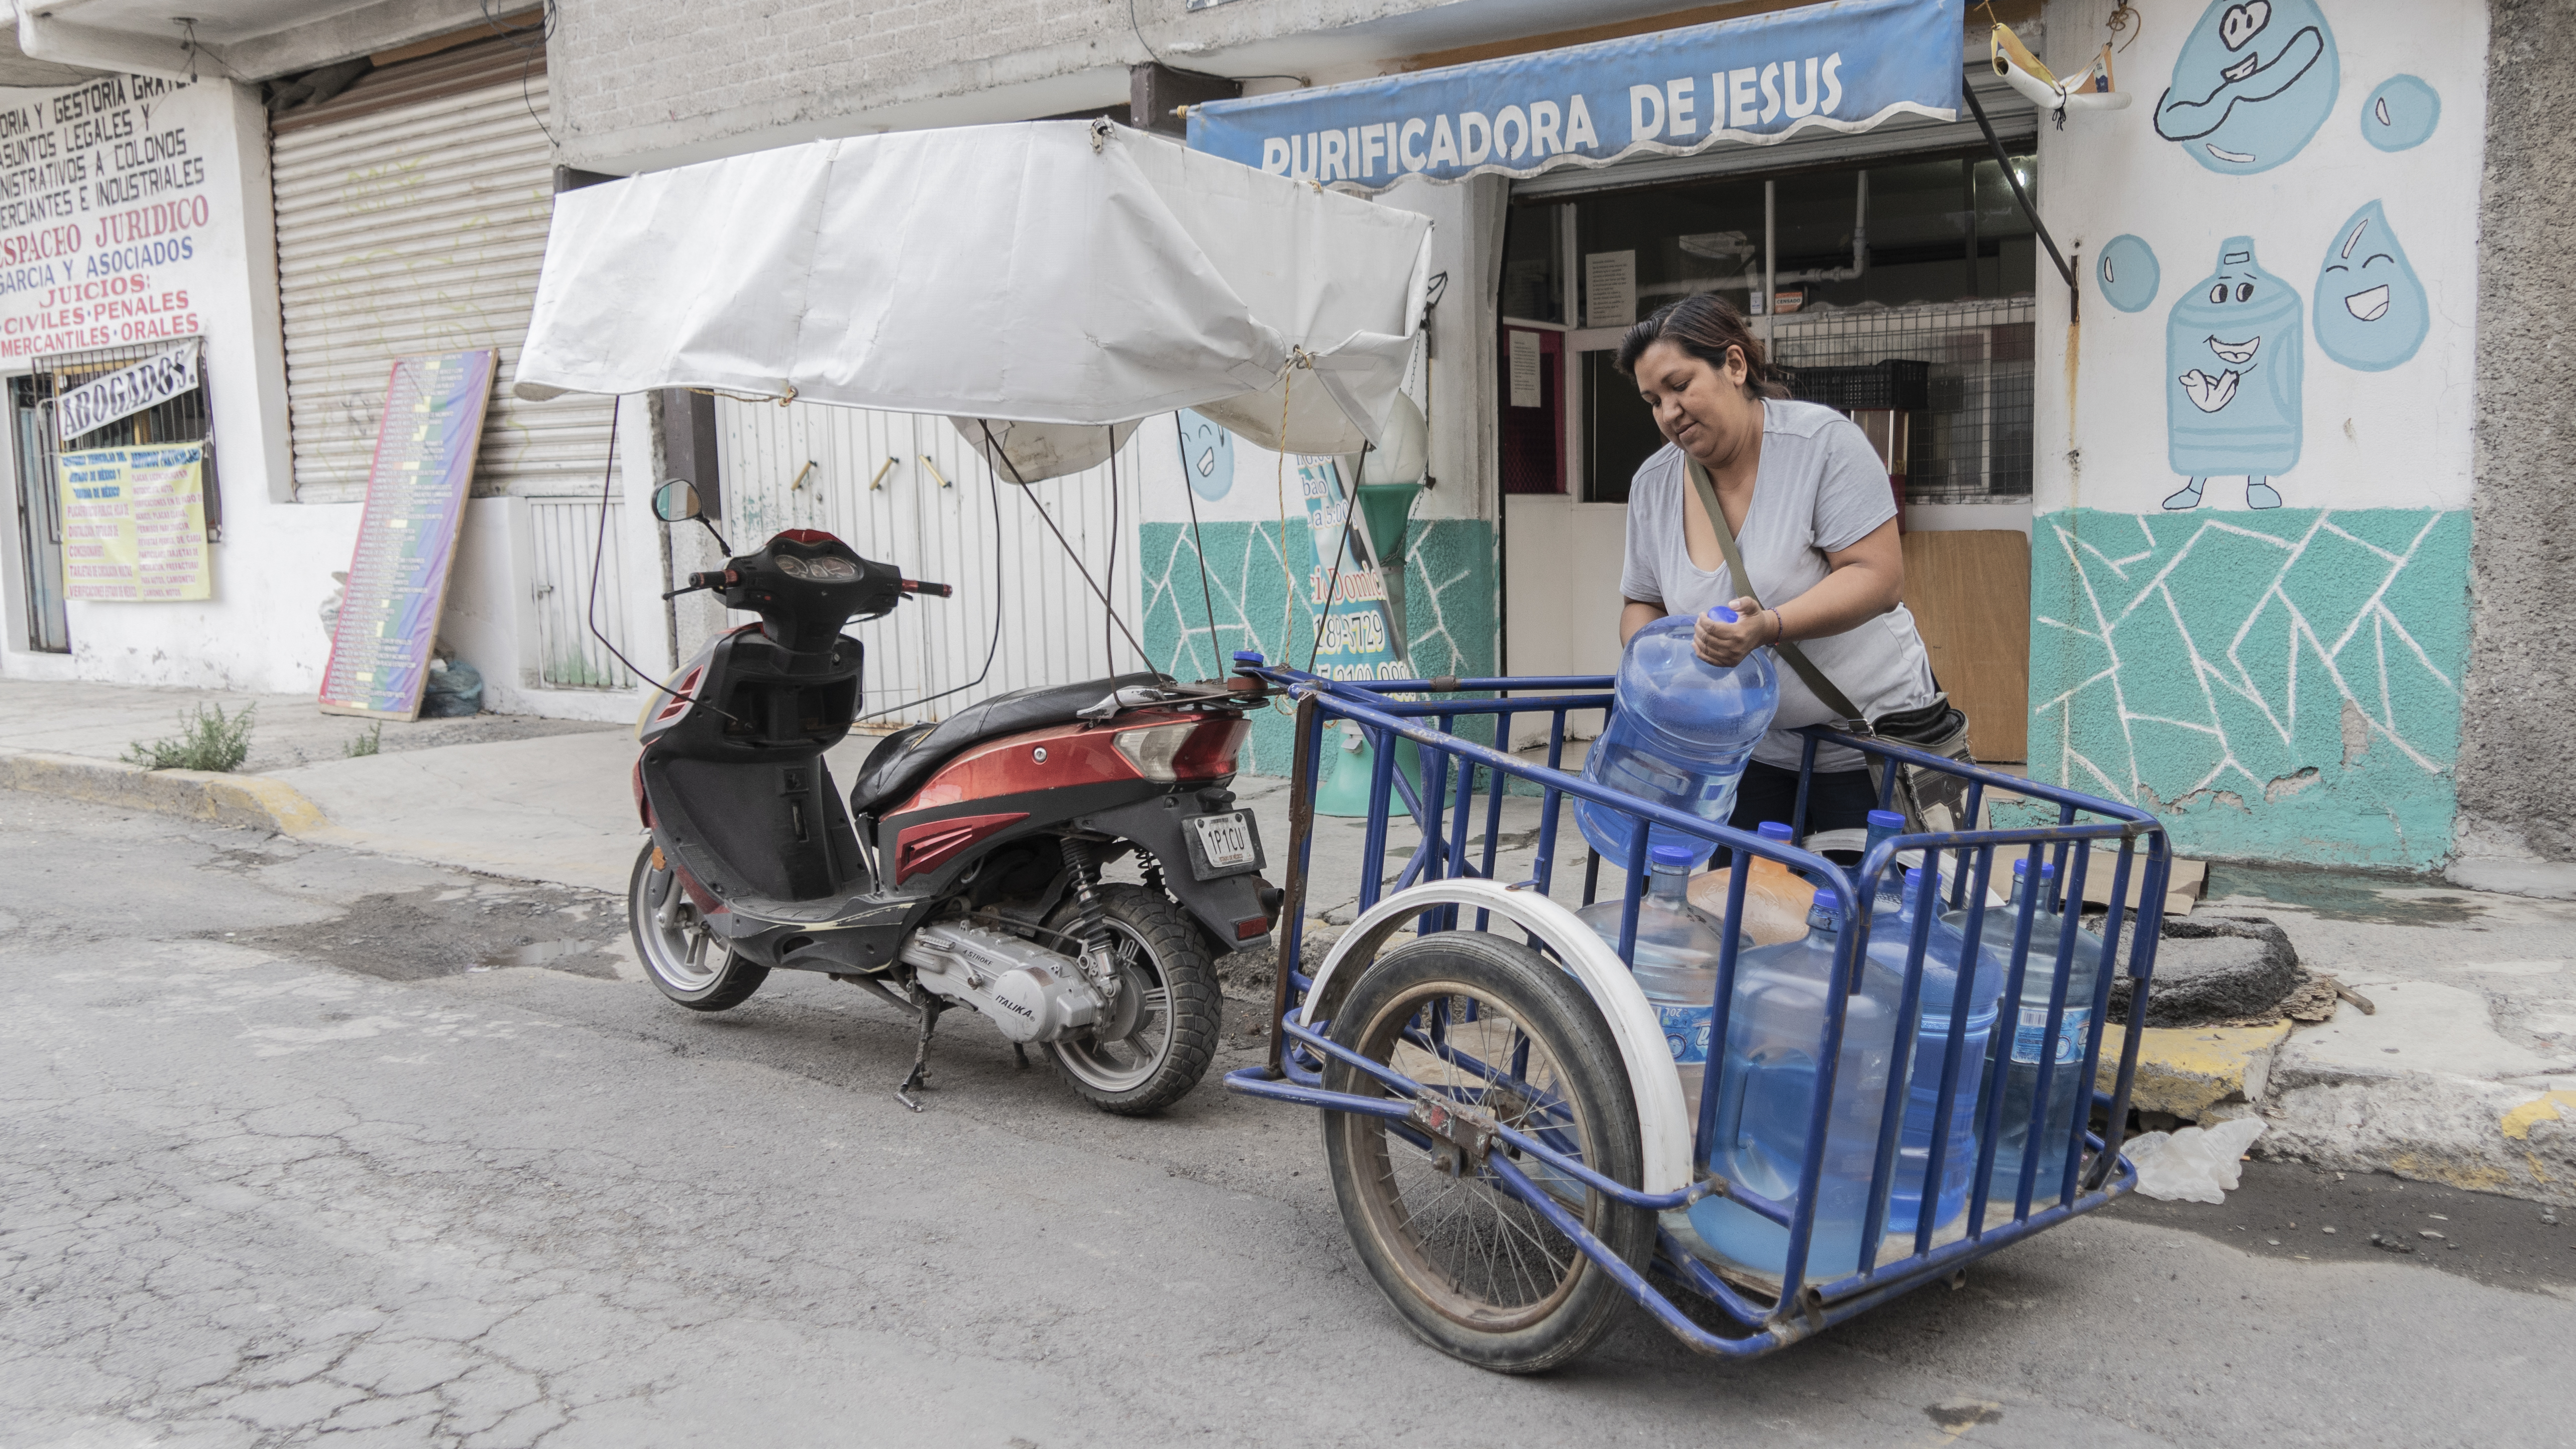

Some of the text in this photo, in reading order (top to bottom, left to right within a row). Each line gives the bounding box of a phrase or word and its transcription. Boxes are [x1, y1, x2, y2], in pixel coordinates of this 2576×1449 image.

[34, 102, 43, 130] Y
[53, 78, 127, 125] GESTORIA
[1262, 52, 1842, 181] PURIFICADORA DE JESUS
[64, 109, 133, 154] LEGALES
[141, 103, 150, 132] Y
[96, 150, 104, 178] A
[115, 128, 187, 171] COLONOS
[79, 185, 90, 211] E
[96, 157, 205, 207] INDUSTRIALES
[95, 194, 209, 248] JURIDICO
[63, 259, 73, 281] Y
[86, 235, 193, 278] ASOCIADOS
[4, 290, 189, 335] CIVILES PENALES
[39, 274, 150, 309] JUICIOS:
[1, 313, 199, 358] MERCANTILES ORALES
[62, 349, 196, 436] ABOGADOS.
[1208, 827, 1245, 854] 1P1CU
[967, 950, 994, 967] STROKE
[995, 995, 1033, 1019] ITALIKA
